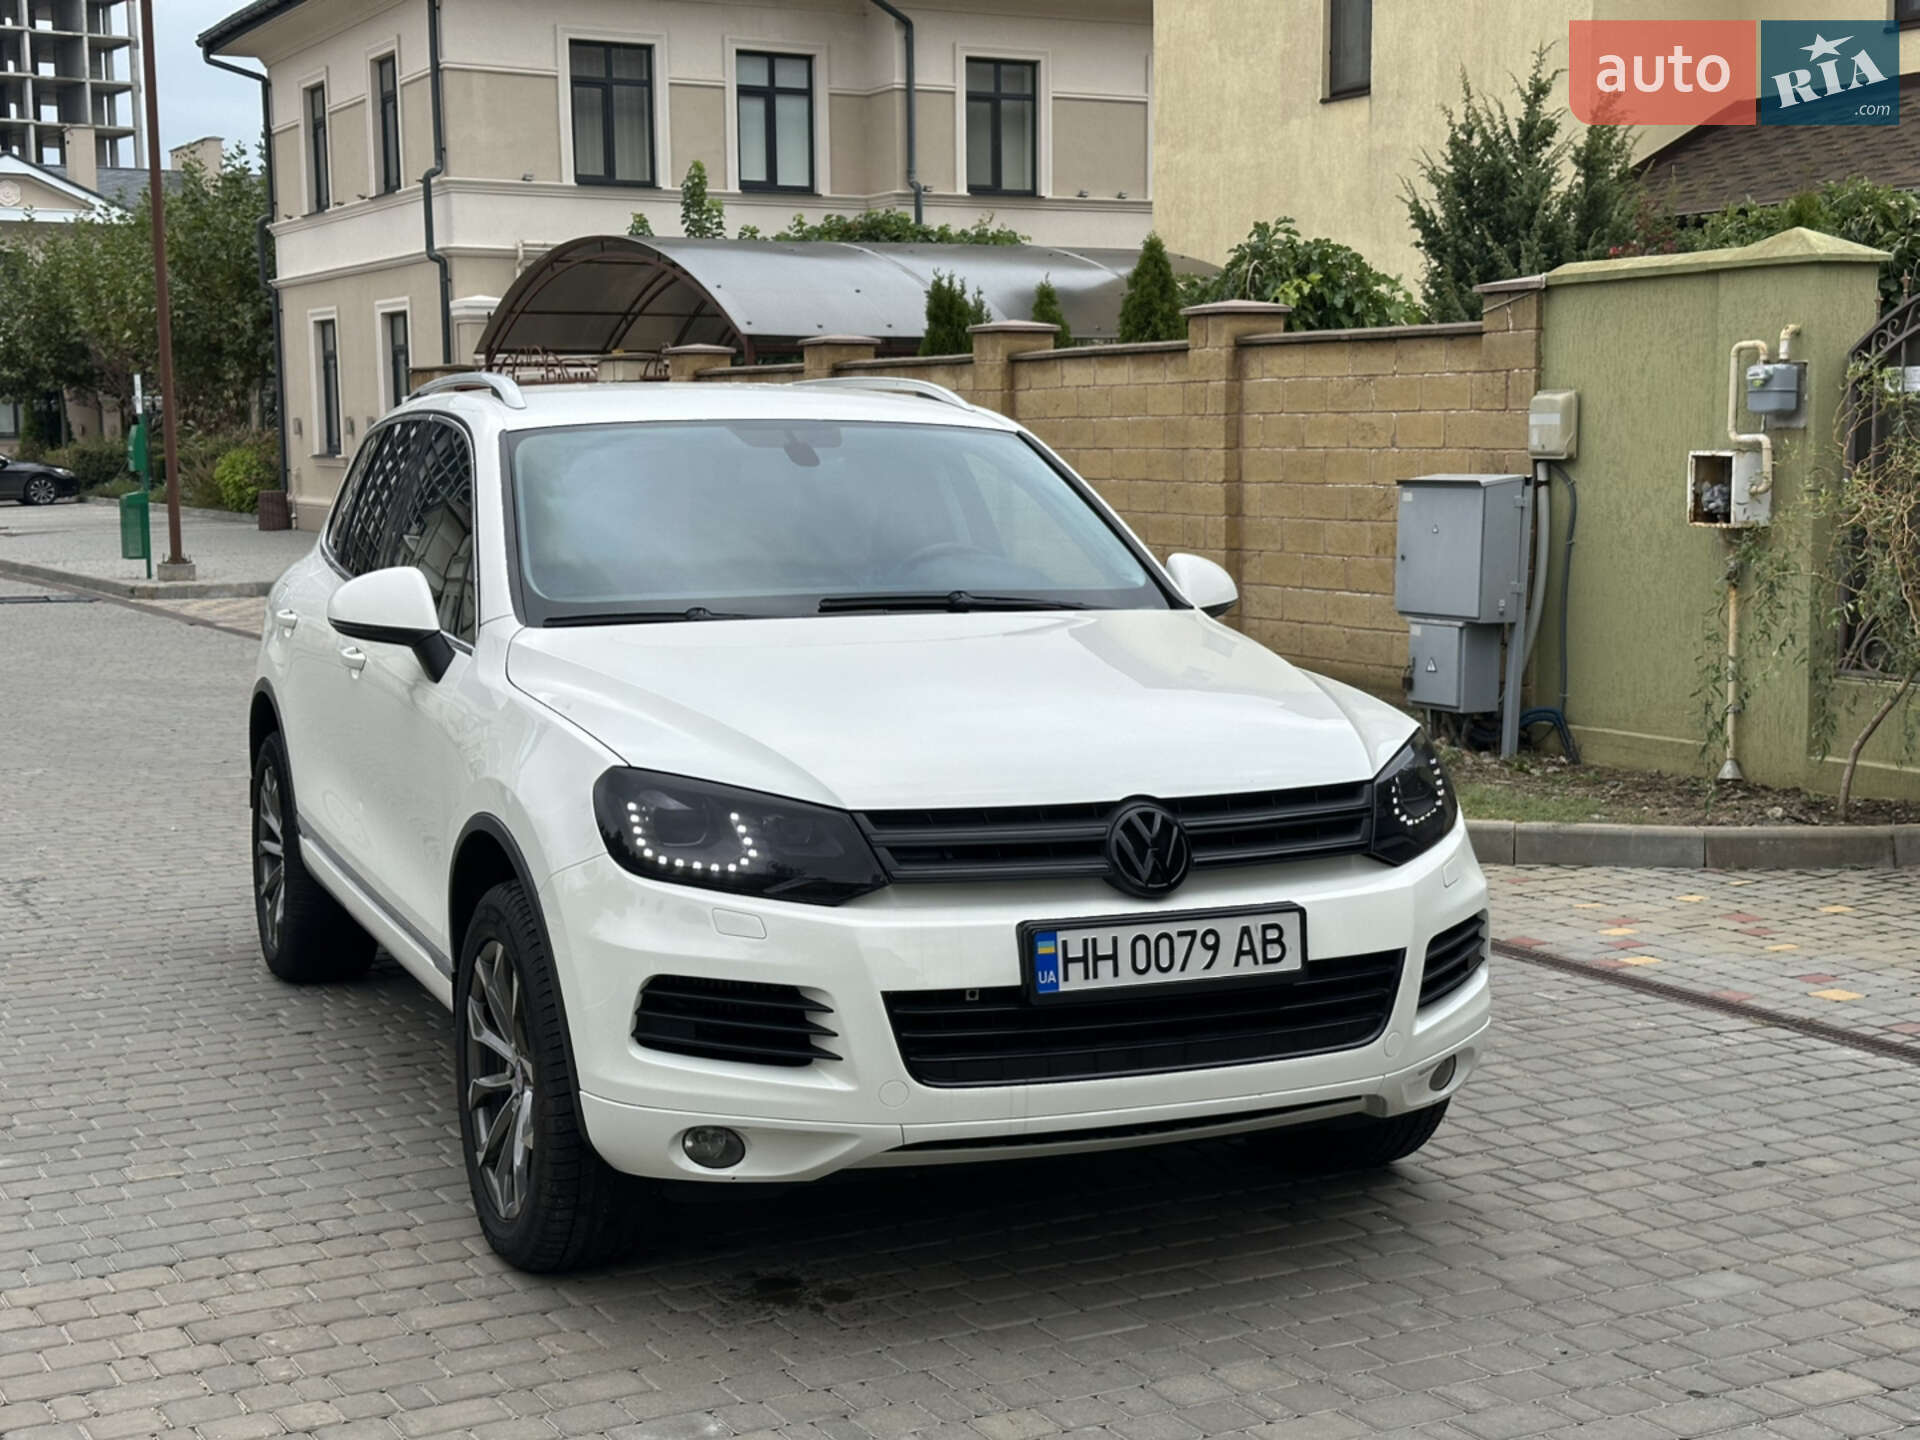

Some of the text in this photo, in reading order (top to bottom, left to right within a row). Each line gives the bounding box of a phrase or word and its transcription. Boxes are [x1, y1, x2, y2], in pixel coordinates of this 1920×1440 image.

[1061, 922, 1287, 982] HH 0079 AB
[1038, 970, 1057, 985] UA
